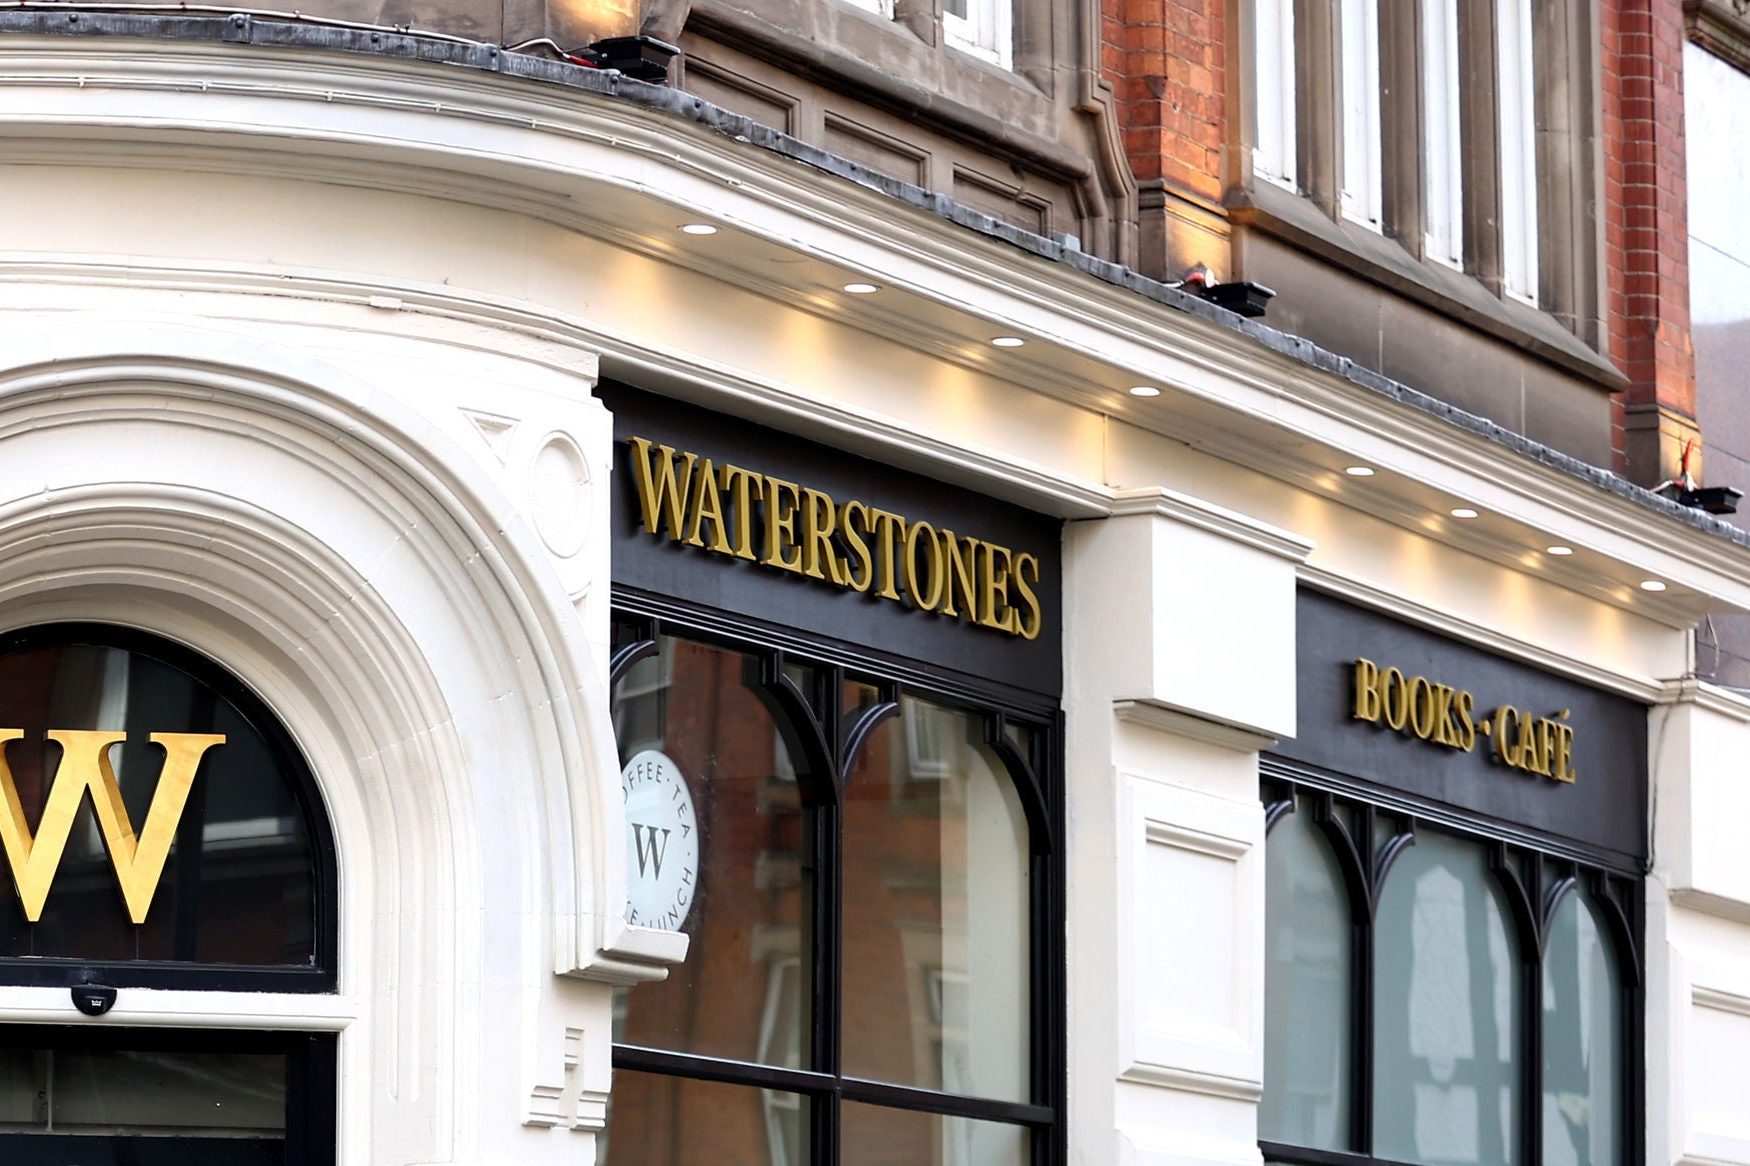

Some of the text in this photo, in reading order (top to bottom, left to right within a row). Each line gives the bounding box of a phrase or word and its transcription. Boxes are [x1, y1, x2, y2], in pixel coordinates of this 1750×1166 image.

[627, 436, 1041, 640] WATERSTONES
[1354, 657, 1576, 784] BOOKS CAFÉ
[622, 762, 693, 931] FFEE TEA UNCH
[631, 822, 671, 882] W
